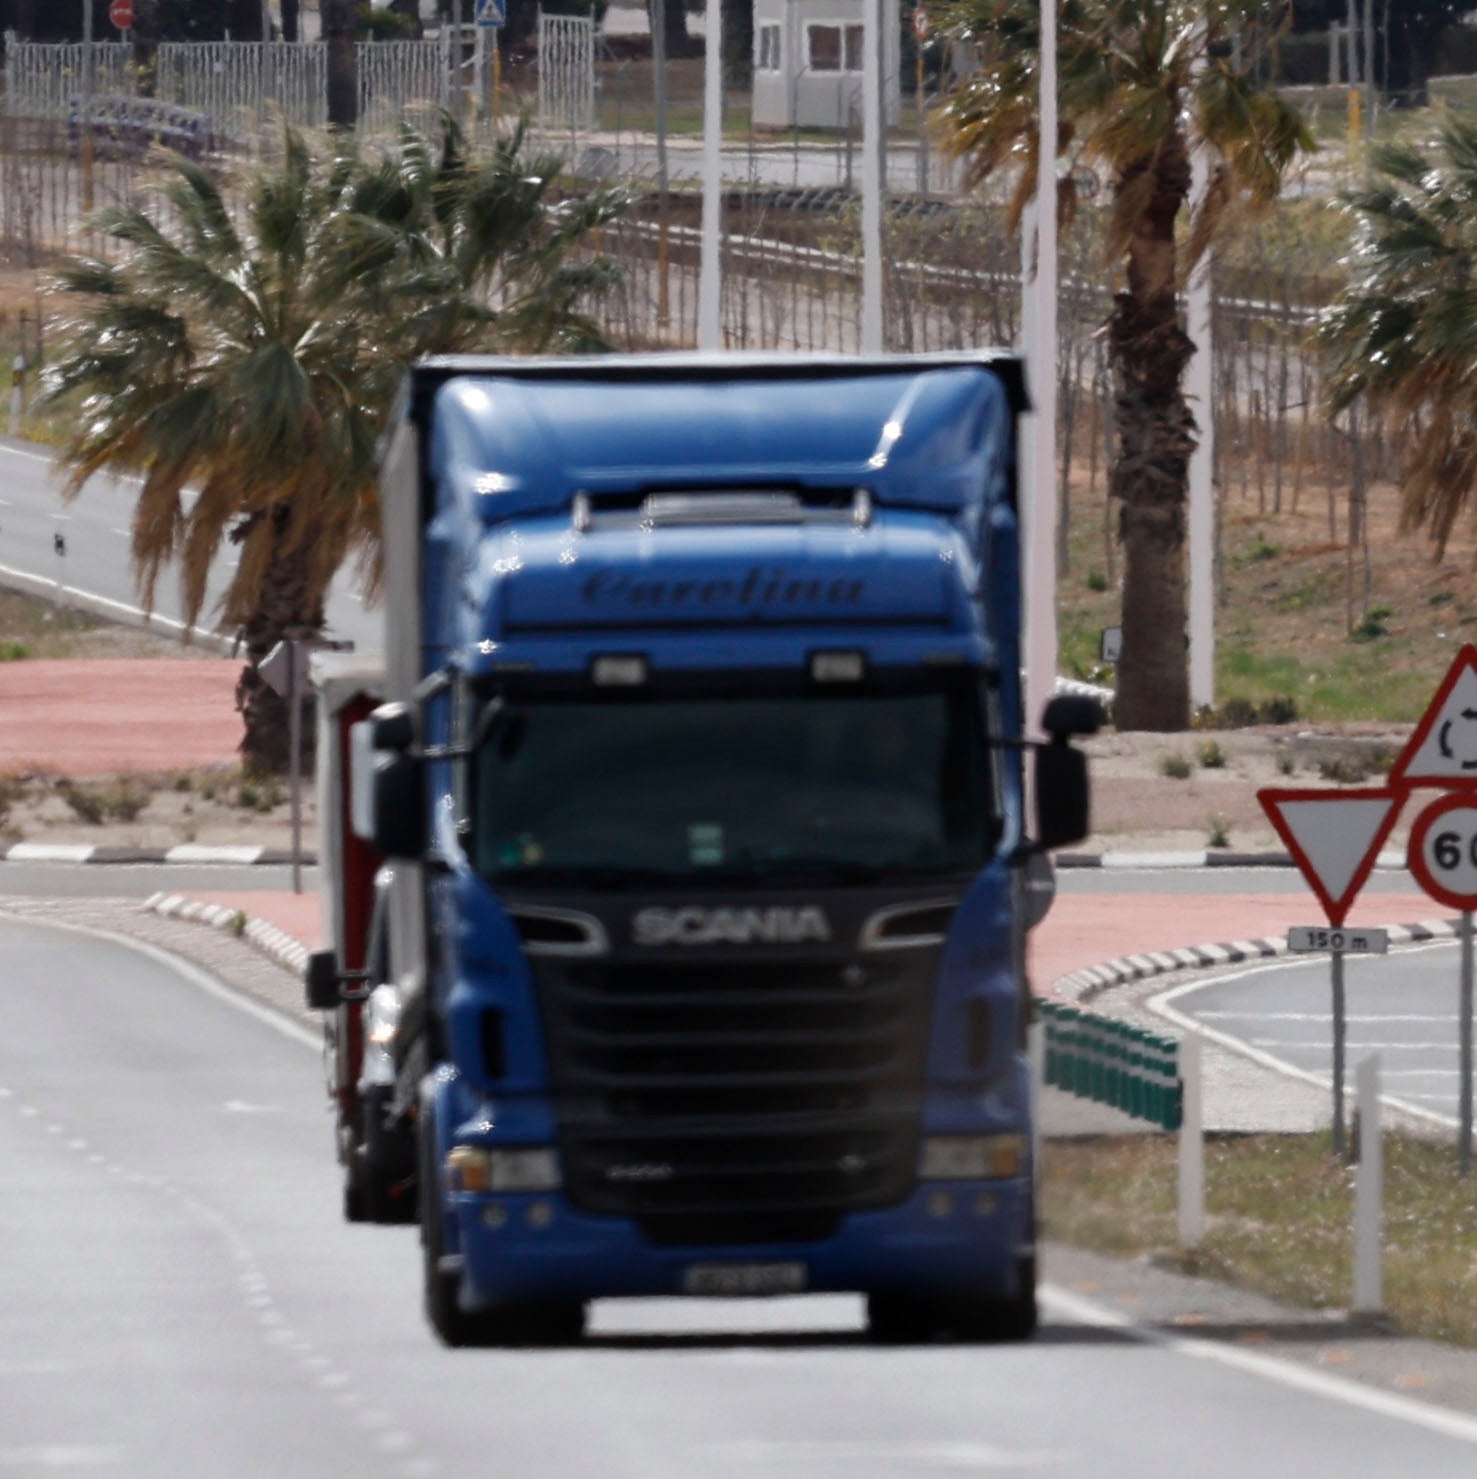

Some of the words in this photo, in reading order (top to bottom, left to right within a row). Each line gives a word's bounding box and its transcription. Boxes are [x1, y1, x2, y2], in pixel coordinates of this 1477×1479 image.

[633, 906, 832, 945] SCANIA
[1307, 931, 1345, 950] 150
[1352, 936, 1369, 950] m
